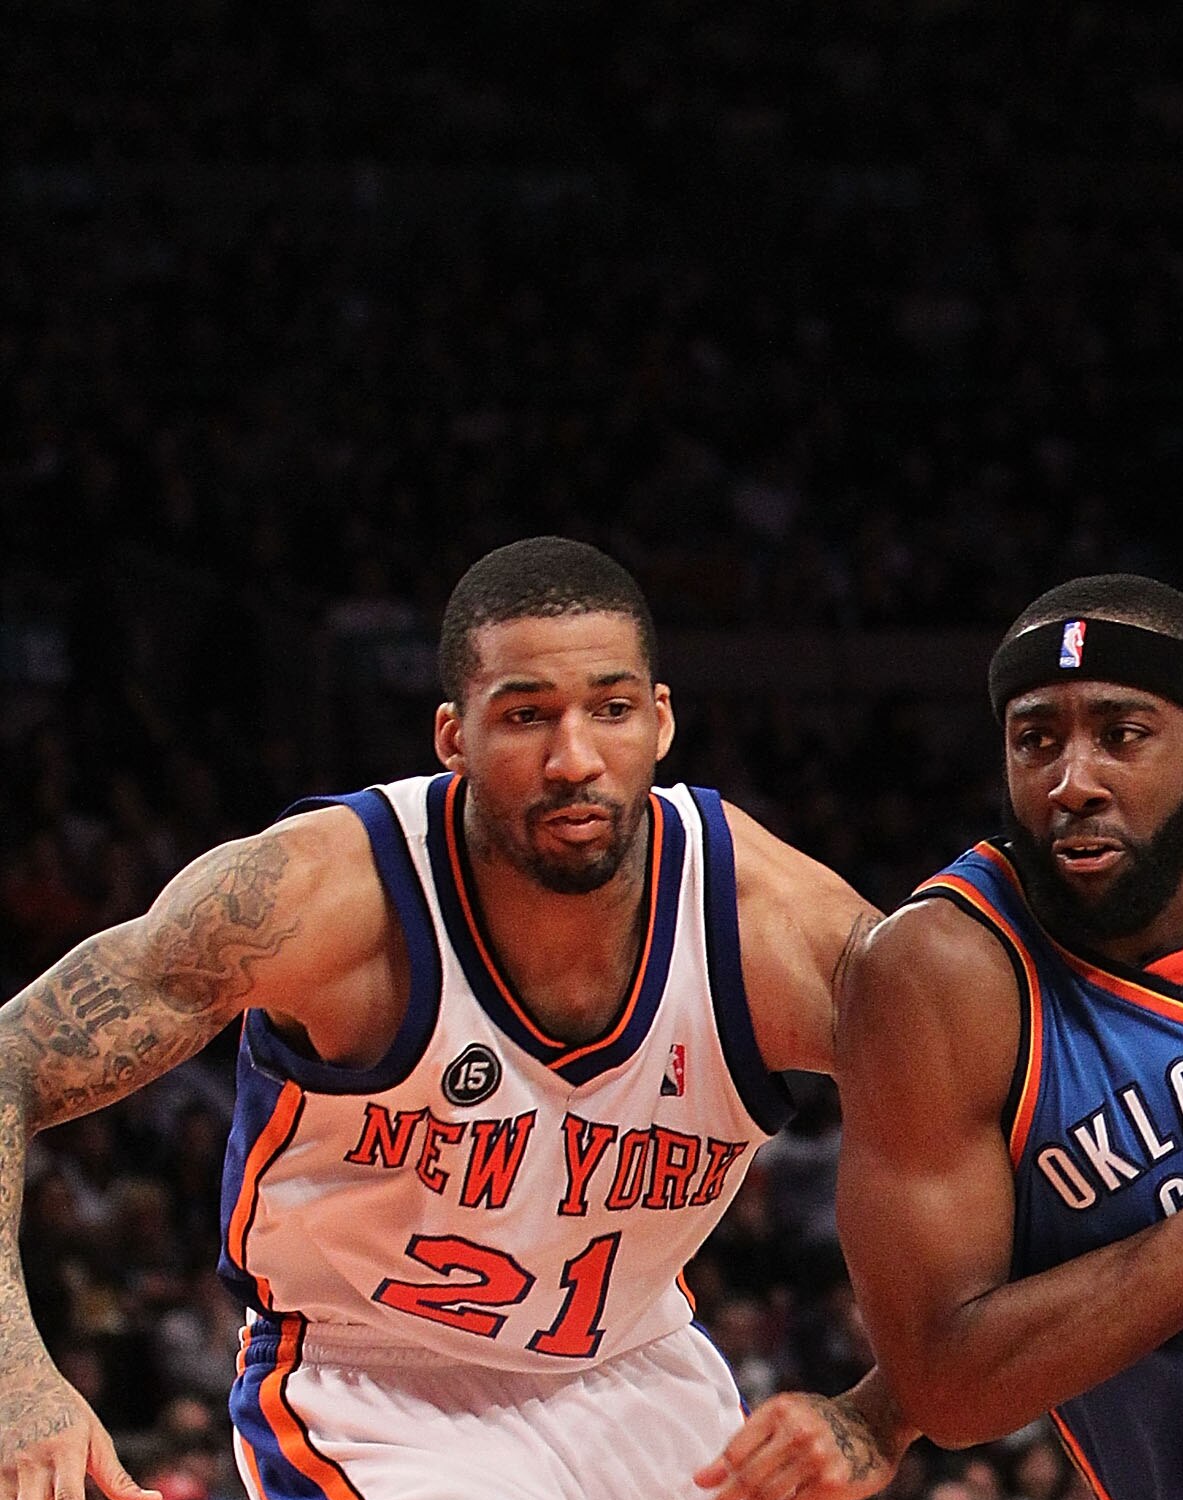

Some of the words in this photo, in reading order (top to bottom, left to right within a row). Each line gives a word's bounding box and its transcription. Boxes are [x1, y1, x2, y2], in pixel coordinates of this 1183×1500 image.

[454, 1062, 490, 1090] 15
[343, 1101, 538, 1209] NEW
[557, 1111, 750, 1217] YORK
[371, 1231, 622, 1358] 21
